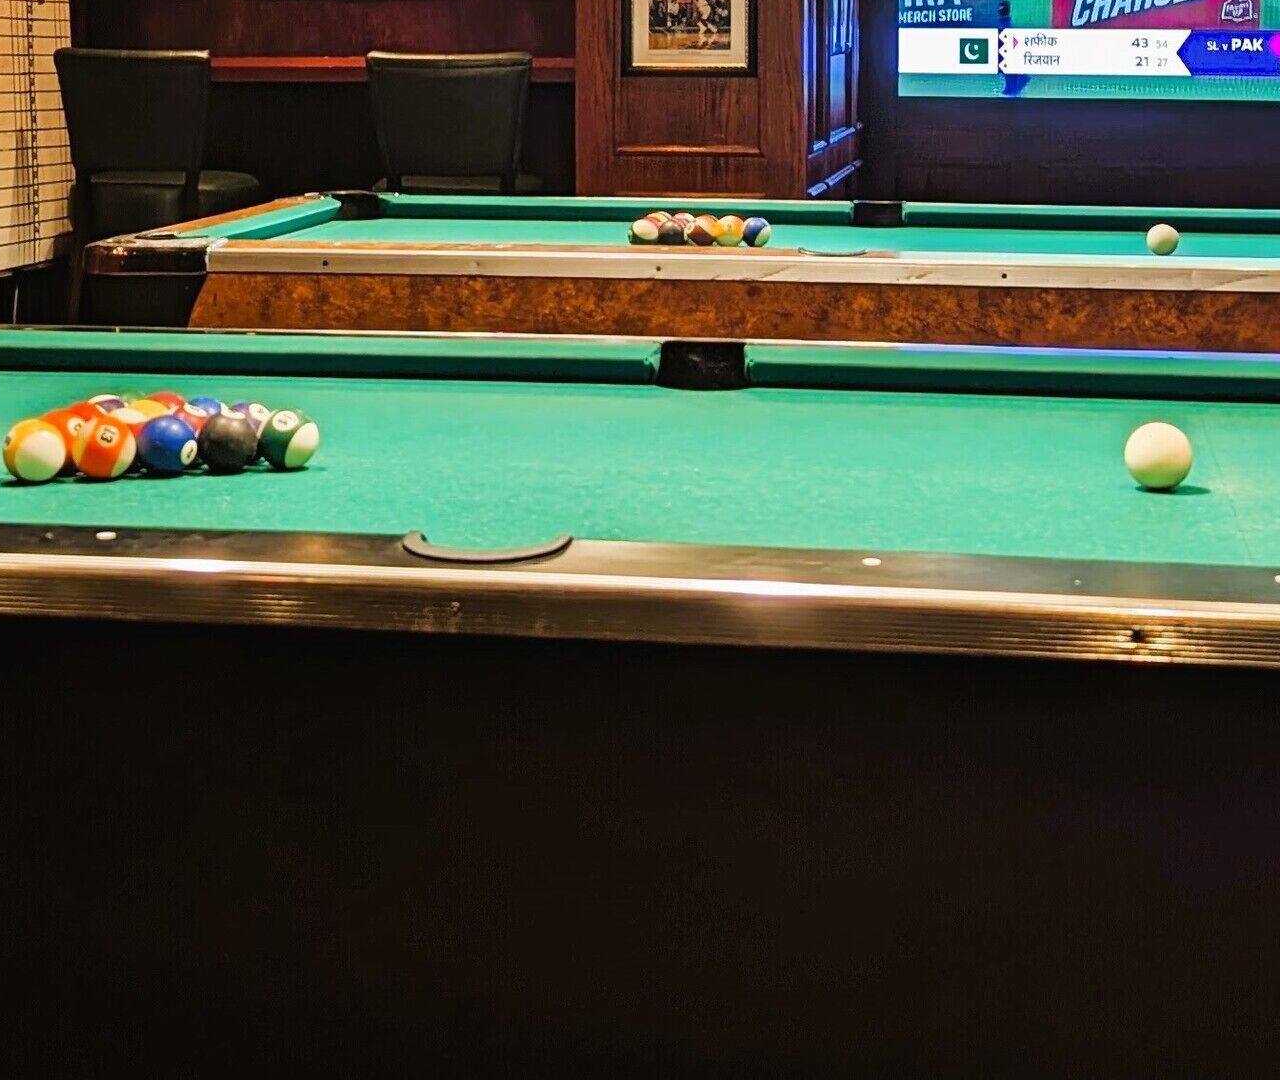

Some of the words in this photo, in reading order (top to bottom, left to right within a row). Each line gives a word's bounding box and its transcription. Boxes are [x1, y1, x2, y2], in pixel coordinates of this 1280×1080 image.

[899, 9, 936, 24] MERCH
[939, 7, 973, 22] STORE
[1024, 32, 1059, 48] शफीक
[1131, 37, 1149, 49] 43
[1155, 39, 1168, 49] 54
[1206, 39, 1219, 52] SL
[1231, 38, 1263, 52] PAK
[1135, 56, 1149, 67] 21
[1157, 58, 1168, 68] 27
